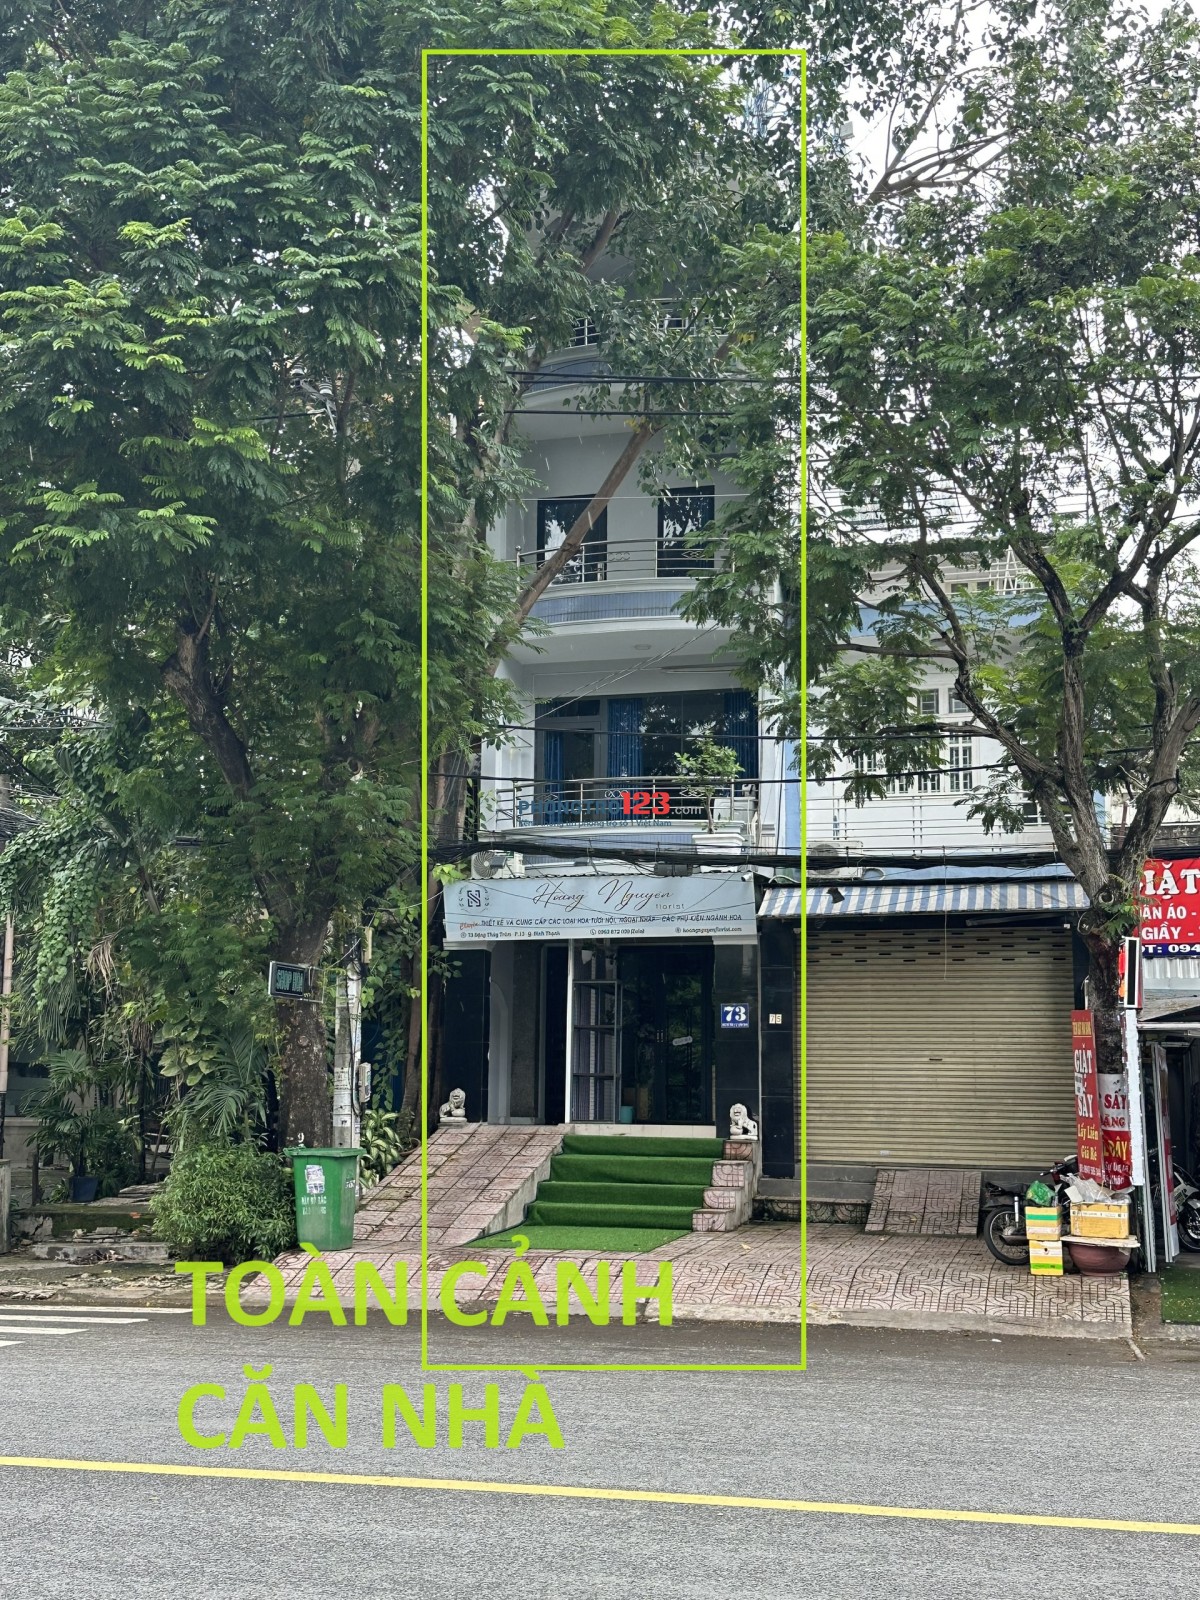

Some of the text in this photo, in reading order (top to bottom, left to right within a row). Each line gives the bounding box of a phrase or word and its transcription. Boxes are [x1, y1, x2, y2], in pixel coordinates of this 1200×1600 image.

[1140, 862, 1200, 899] IẶT
[516, 917, 533, 926] CUNG
[729, 913, 742, 921] HOA
[1166, 903, 1187, 920] ÁO
[723, 1006, 747, 1022] 73
[1075, 1043, 1093, 1078] GIẶT
